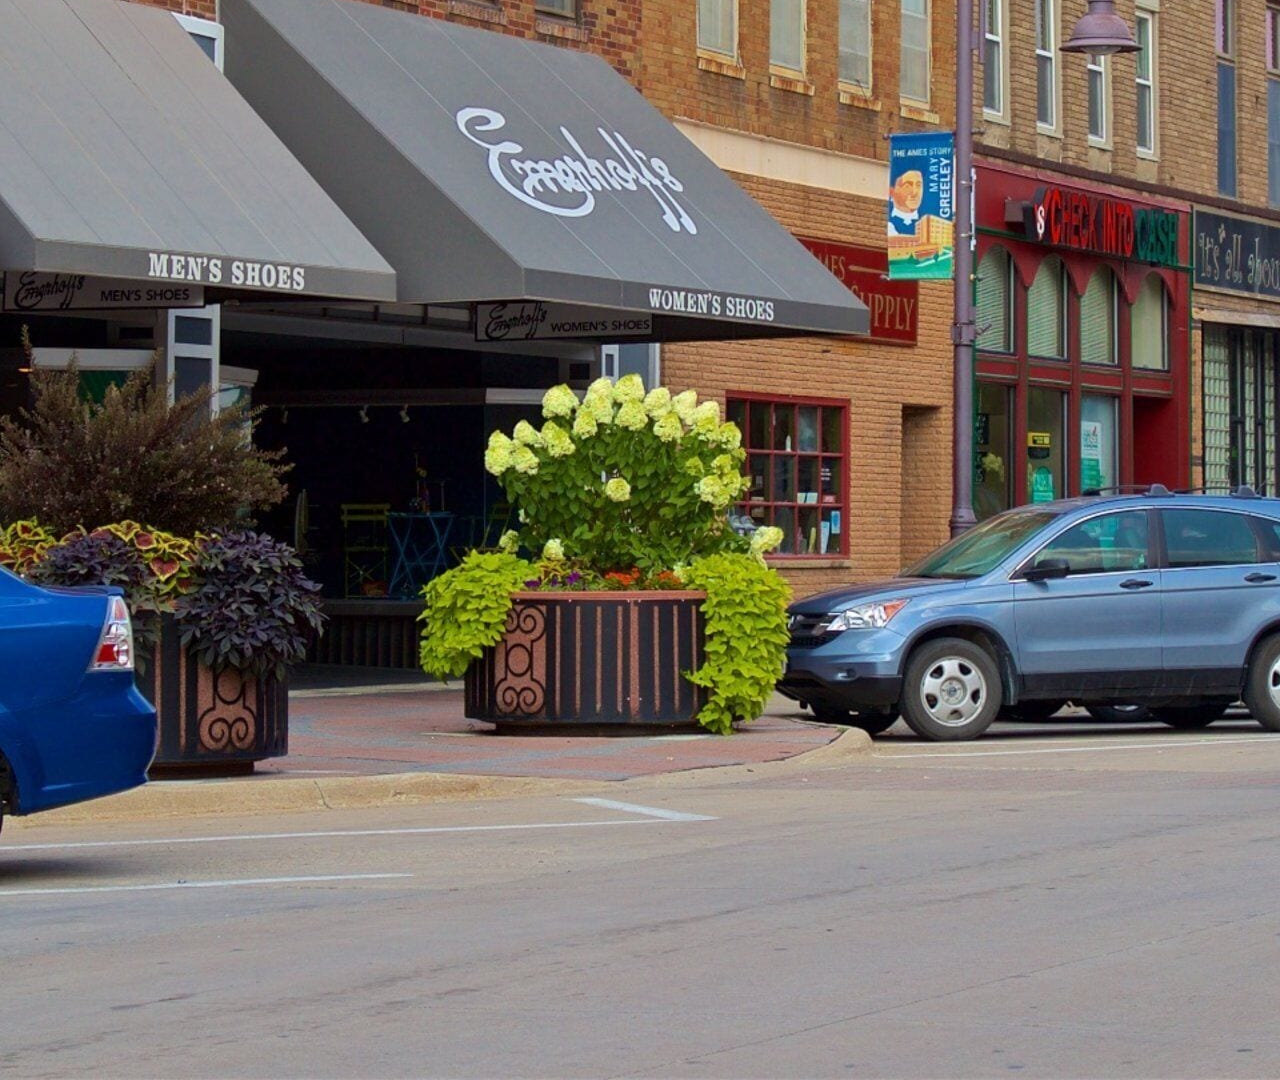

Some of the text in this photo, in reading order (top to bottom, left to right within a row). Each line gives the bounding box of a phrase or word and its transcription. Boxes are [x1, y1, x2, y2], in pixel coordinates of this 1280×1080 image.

[893, 146, 951, 157] THE AMES STORY
[929, 157, 939, 193] MARY
[939, 157, 951, 218] GREELEY
[1050, 187, 1098, 252] CHECK
[1102, 198, 1135, 259] INTO
[1136, 207, 1180, 266] CASH
[148, 252, 305, 291] MEN'S SHOES
[100, 288, 141, 302] MEN'S
[147, 288, 190, 301] SHOES
[649, 288, 775, 321] WOMEN'S SHOES
[550, 320, 608, 333] WOMEN'S
[611, 319, 650, 331] SHOES
